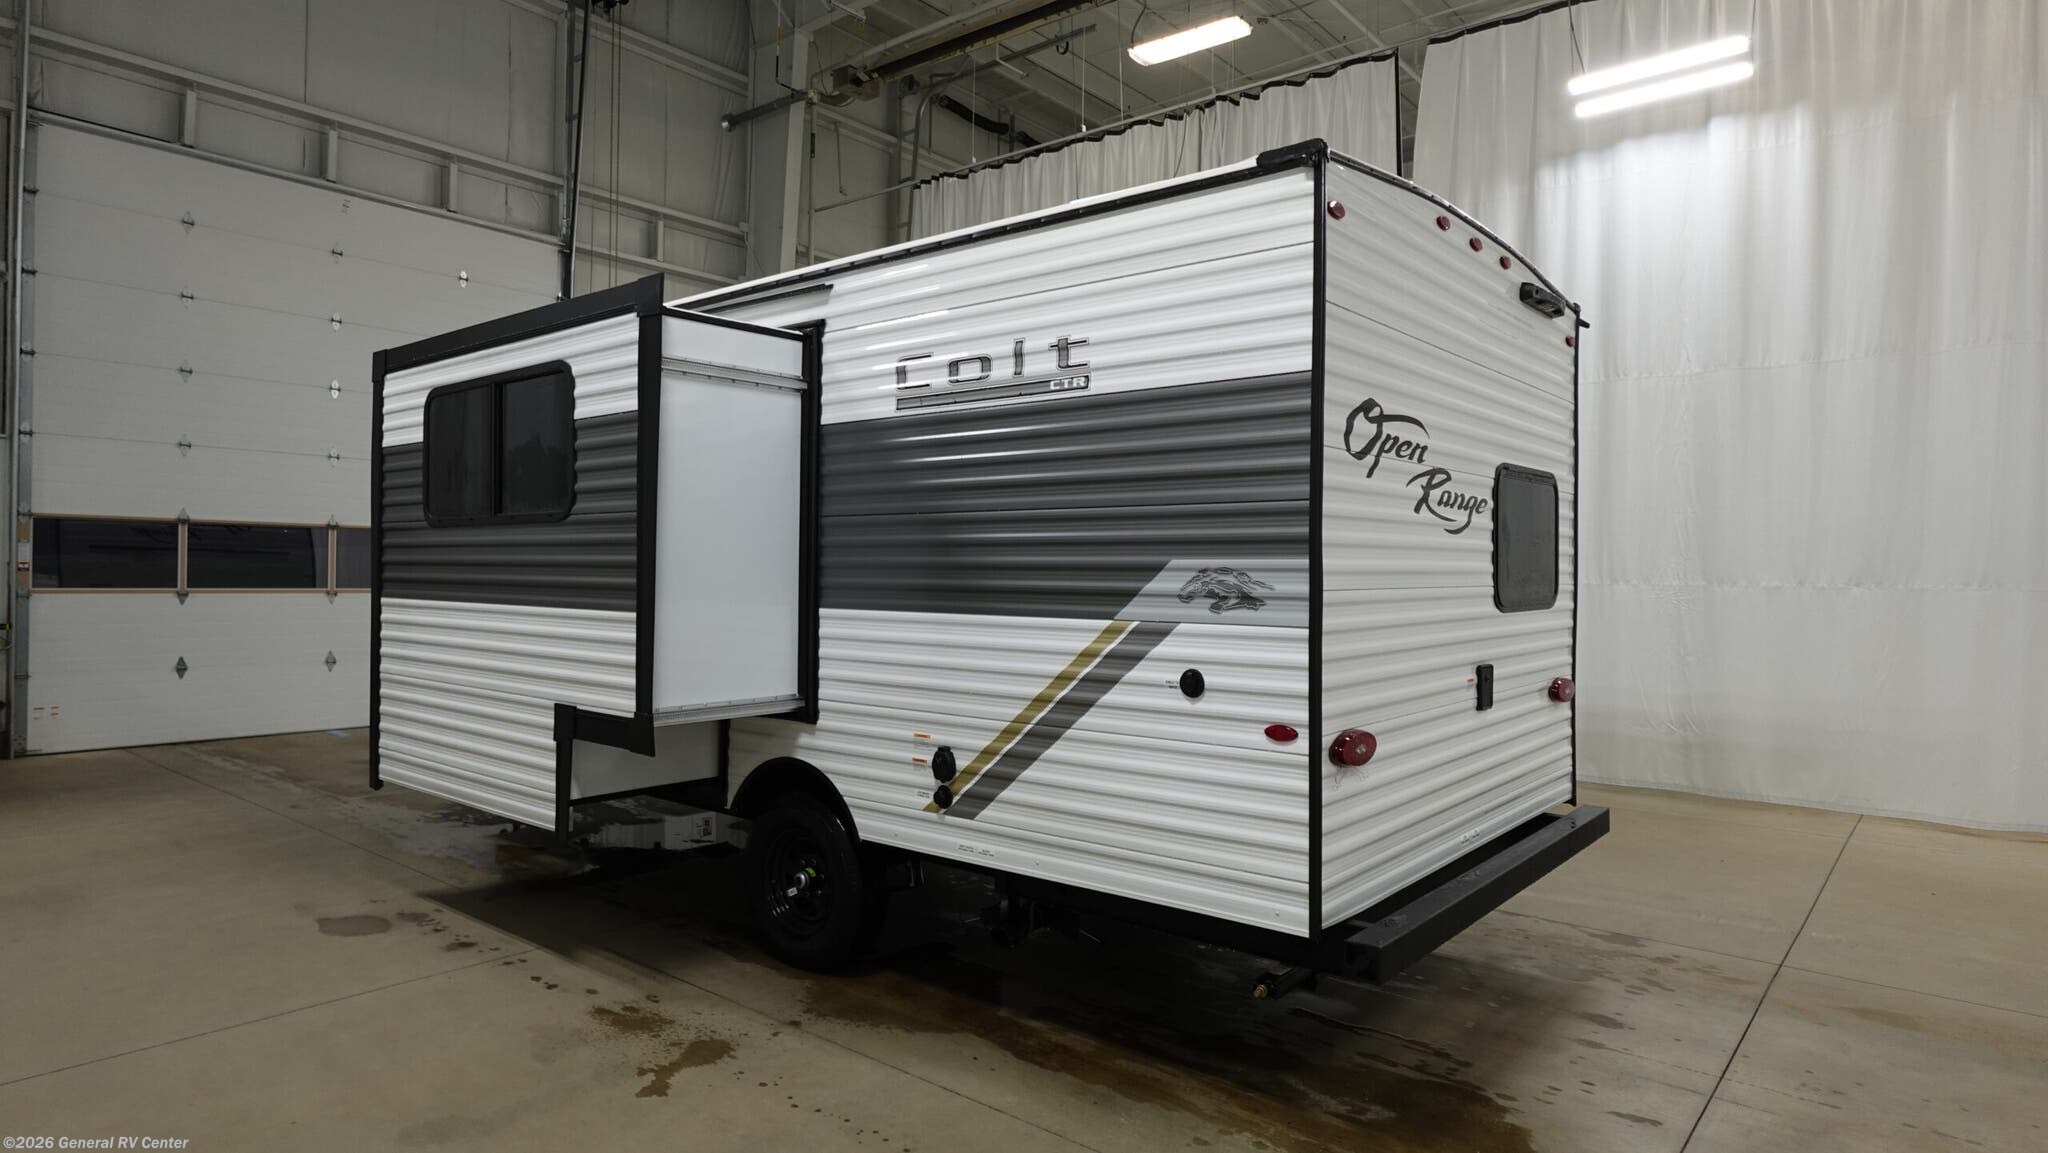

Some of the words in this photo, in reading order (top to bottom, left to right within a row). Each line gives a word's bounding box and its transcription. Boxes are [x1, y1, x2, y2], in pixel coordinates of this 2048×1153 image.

[895, 335, 1090, 390] Colt
[1050, 377, 1086, 390] CTR
[1344, 398, 1431, 478] Open
[1406, 467, 1488, 534] Range
